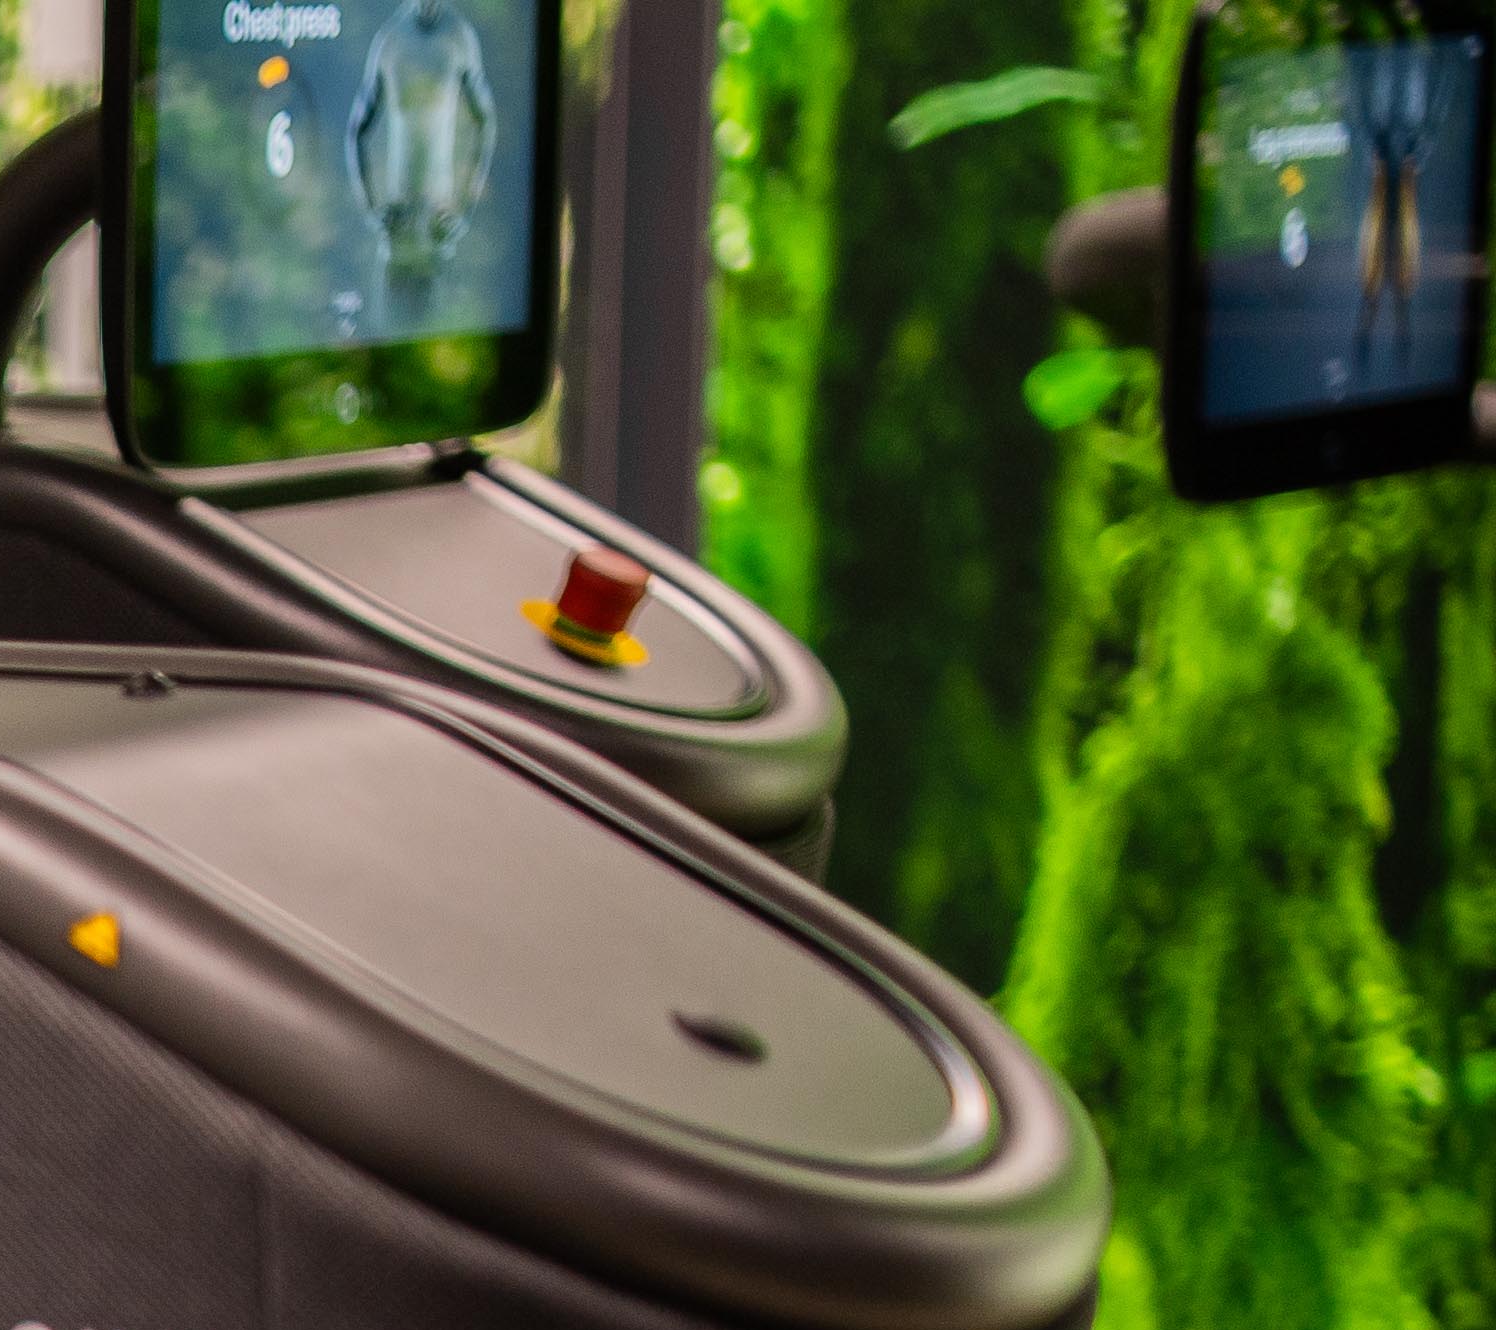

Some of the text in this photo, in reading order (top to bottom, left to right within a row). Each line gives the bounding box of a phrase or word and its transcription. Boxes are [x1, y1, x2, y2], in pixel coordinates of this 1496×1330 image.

[223, 0, 341, 48] Chest press
[266, 110, 295, 178] 6
